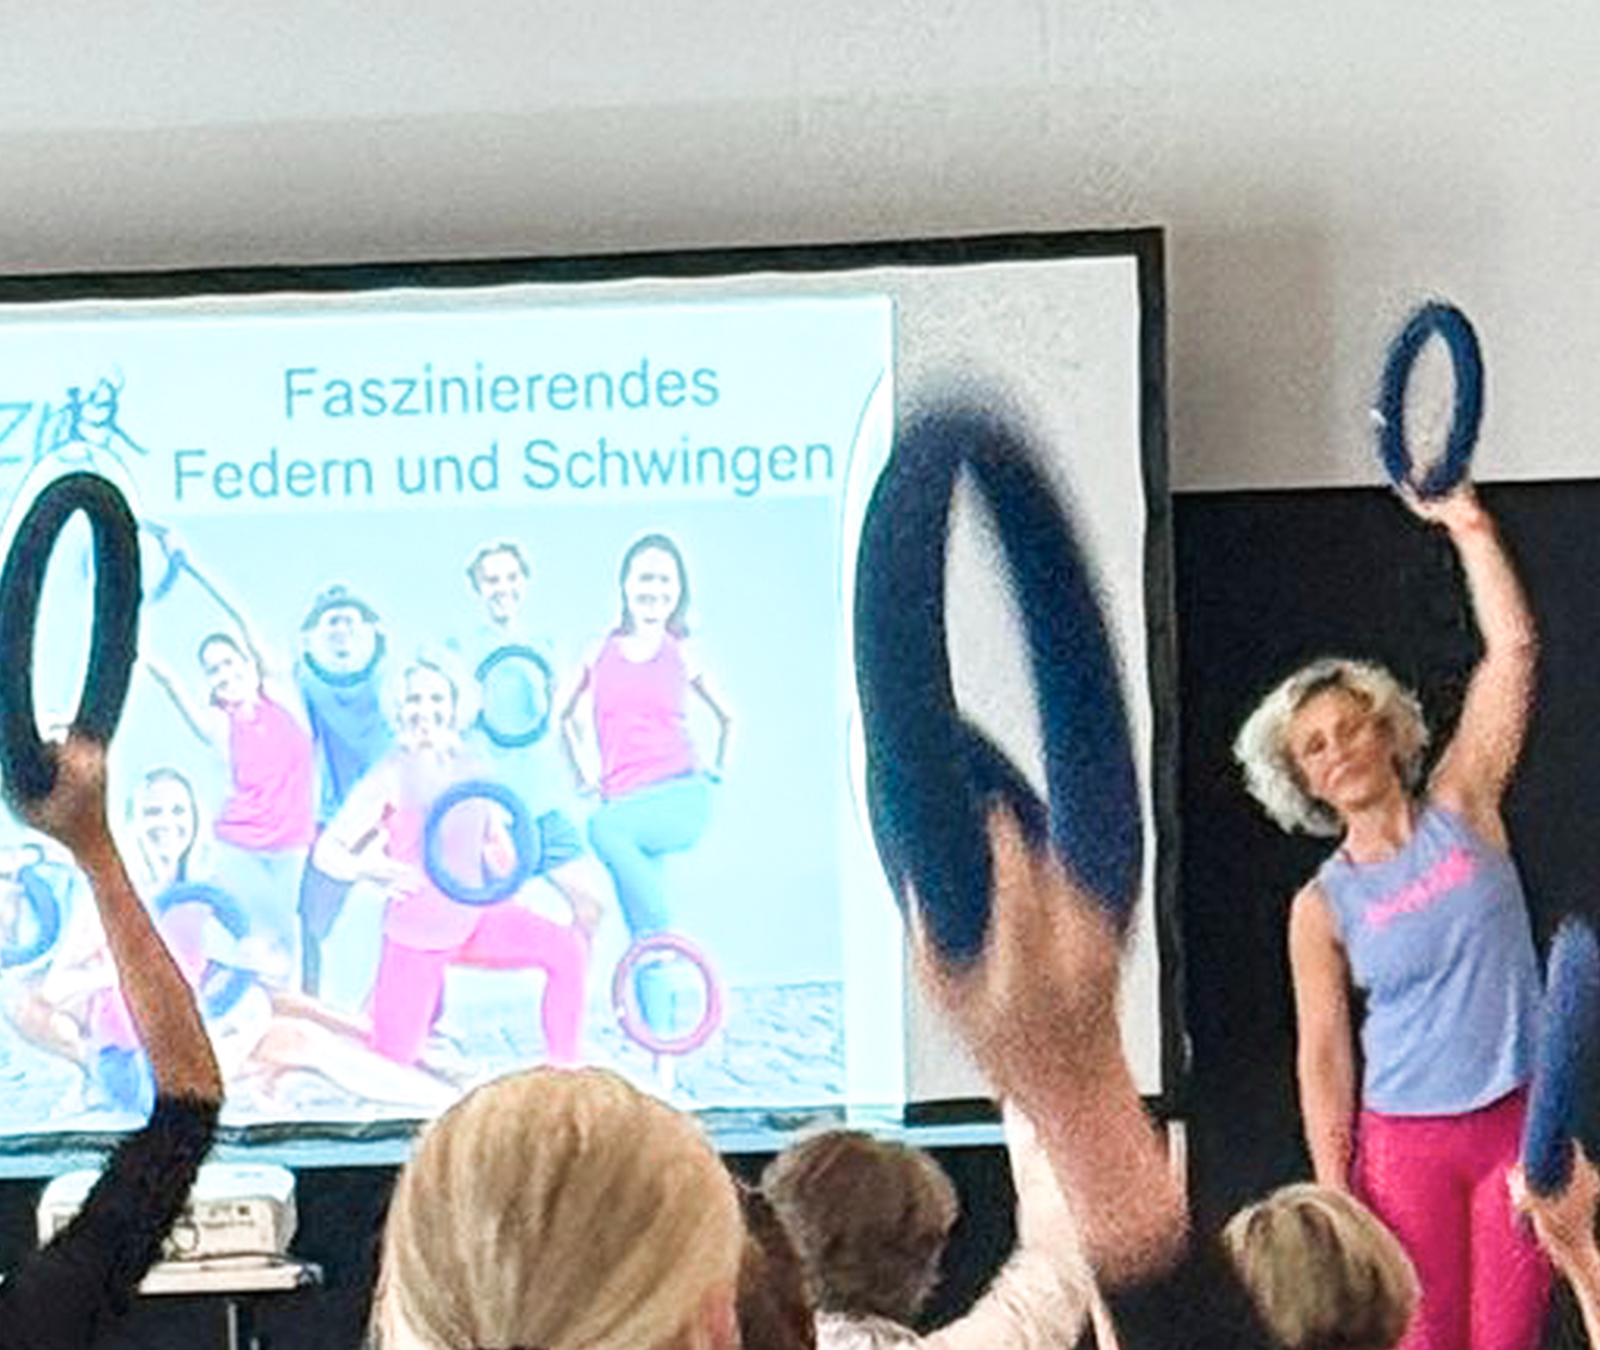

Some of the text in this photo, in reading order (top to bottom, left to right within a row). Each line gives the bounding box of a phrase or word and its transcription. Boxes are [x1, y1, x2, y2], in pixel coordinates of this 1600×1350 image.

[284, 355, 721, 419] Faszinierendes
[173, 432, 835, 501] Federn und Schwingen
